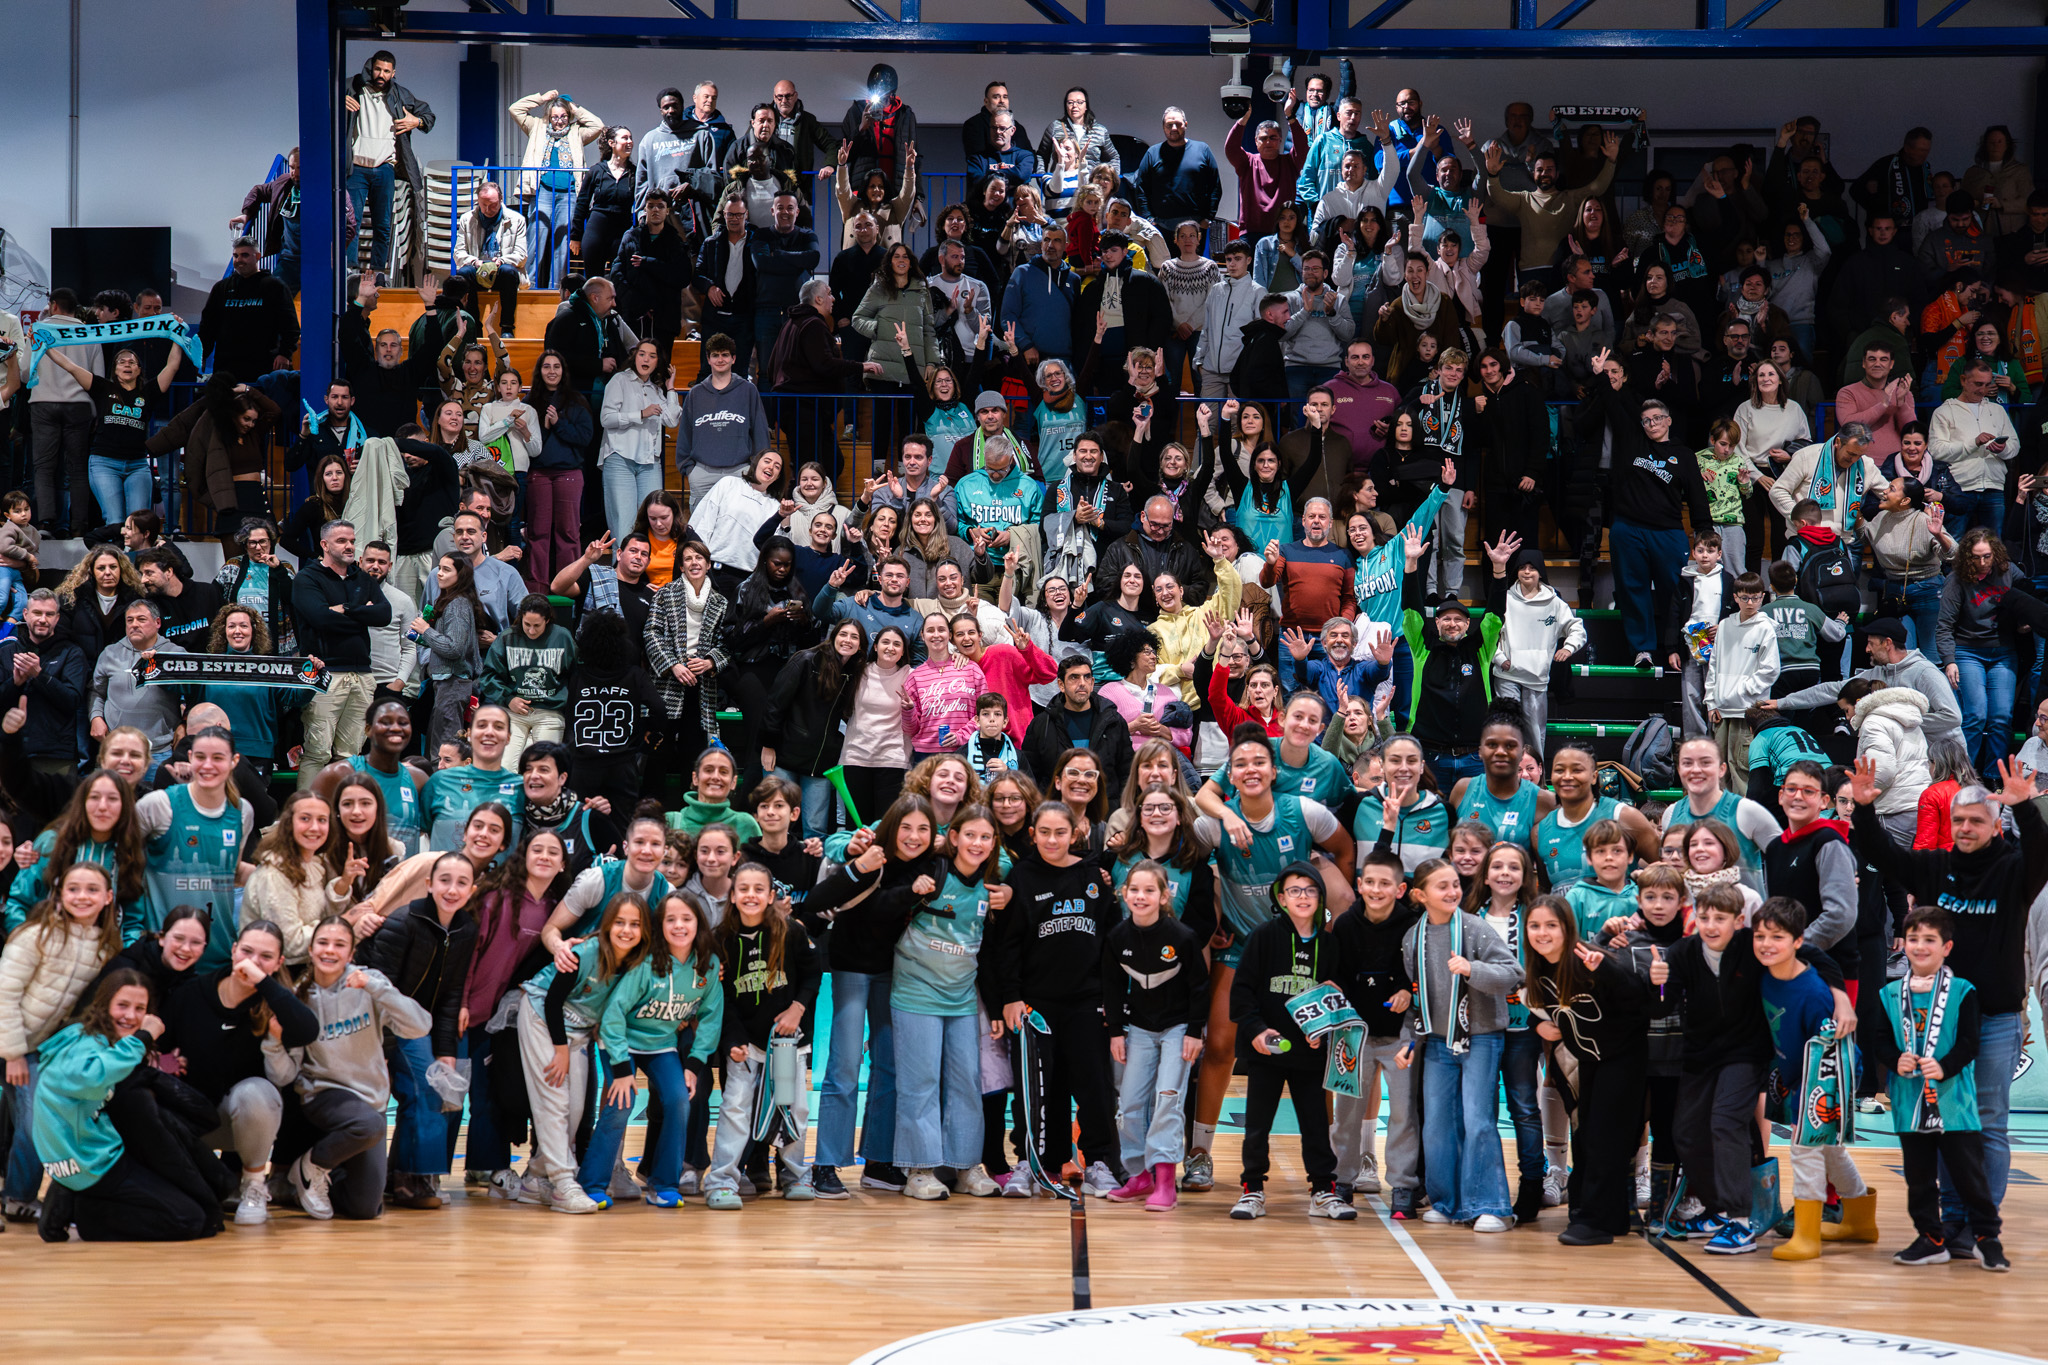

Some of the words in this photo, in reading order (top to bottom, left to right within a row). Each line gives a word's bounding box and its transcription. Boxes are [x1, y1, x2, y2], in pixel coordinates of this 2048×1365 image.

[58, 318, 186, 340] ESTEPONA
[111, 403, 143, 418] CAB
[104, 415, 147, 430] ESTEPONA
[694, 411, 745, 428] scuffers
[1046, 426, 1065, 436] SGM
[1059, 438, 1074, 452] 15
[1632, 457, 1673, 484] ESTEPONA
[971, 503, 1022, 524] ESTEPONA
[238, 596, 263, 604] SGM
[1773, 607, 1806, 624] NYC
[165, 617, 209, 637] ESTEPONA
[163, 661, 199, 673] CAB
[202, 662, 294, 676] ESTEPONA
[505, 646, 533, 671] NEW
[534, 648, 564, 675] YORK
[580, 686, 629, 697] STAFF
[915, 680, 945, 702] My
[945, 678, 978, 697] Own
[921, 696, 968, 717] Rhythm
[573, 699, 634, 747] 23
[174, 878, 212, 891] SGM
[1241, 885, 1271, 897] SGM
[1051, 899, 1085, 915] CAB
[1038, 917, 1096, 938] ESTEPONA
[929, 939, 965, 956] SGM
[1129, 1303, 1555, 1320] AYUNTAMIENTO
[1577, 1309, 1656, 1322] DE
[1671, 1316, 1960, 1360] ESTEPONA
